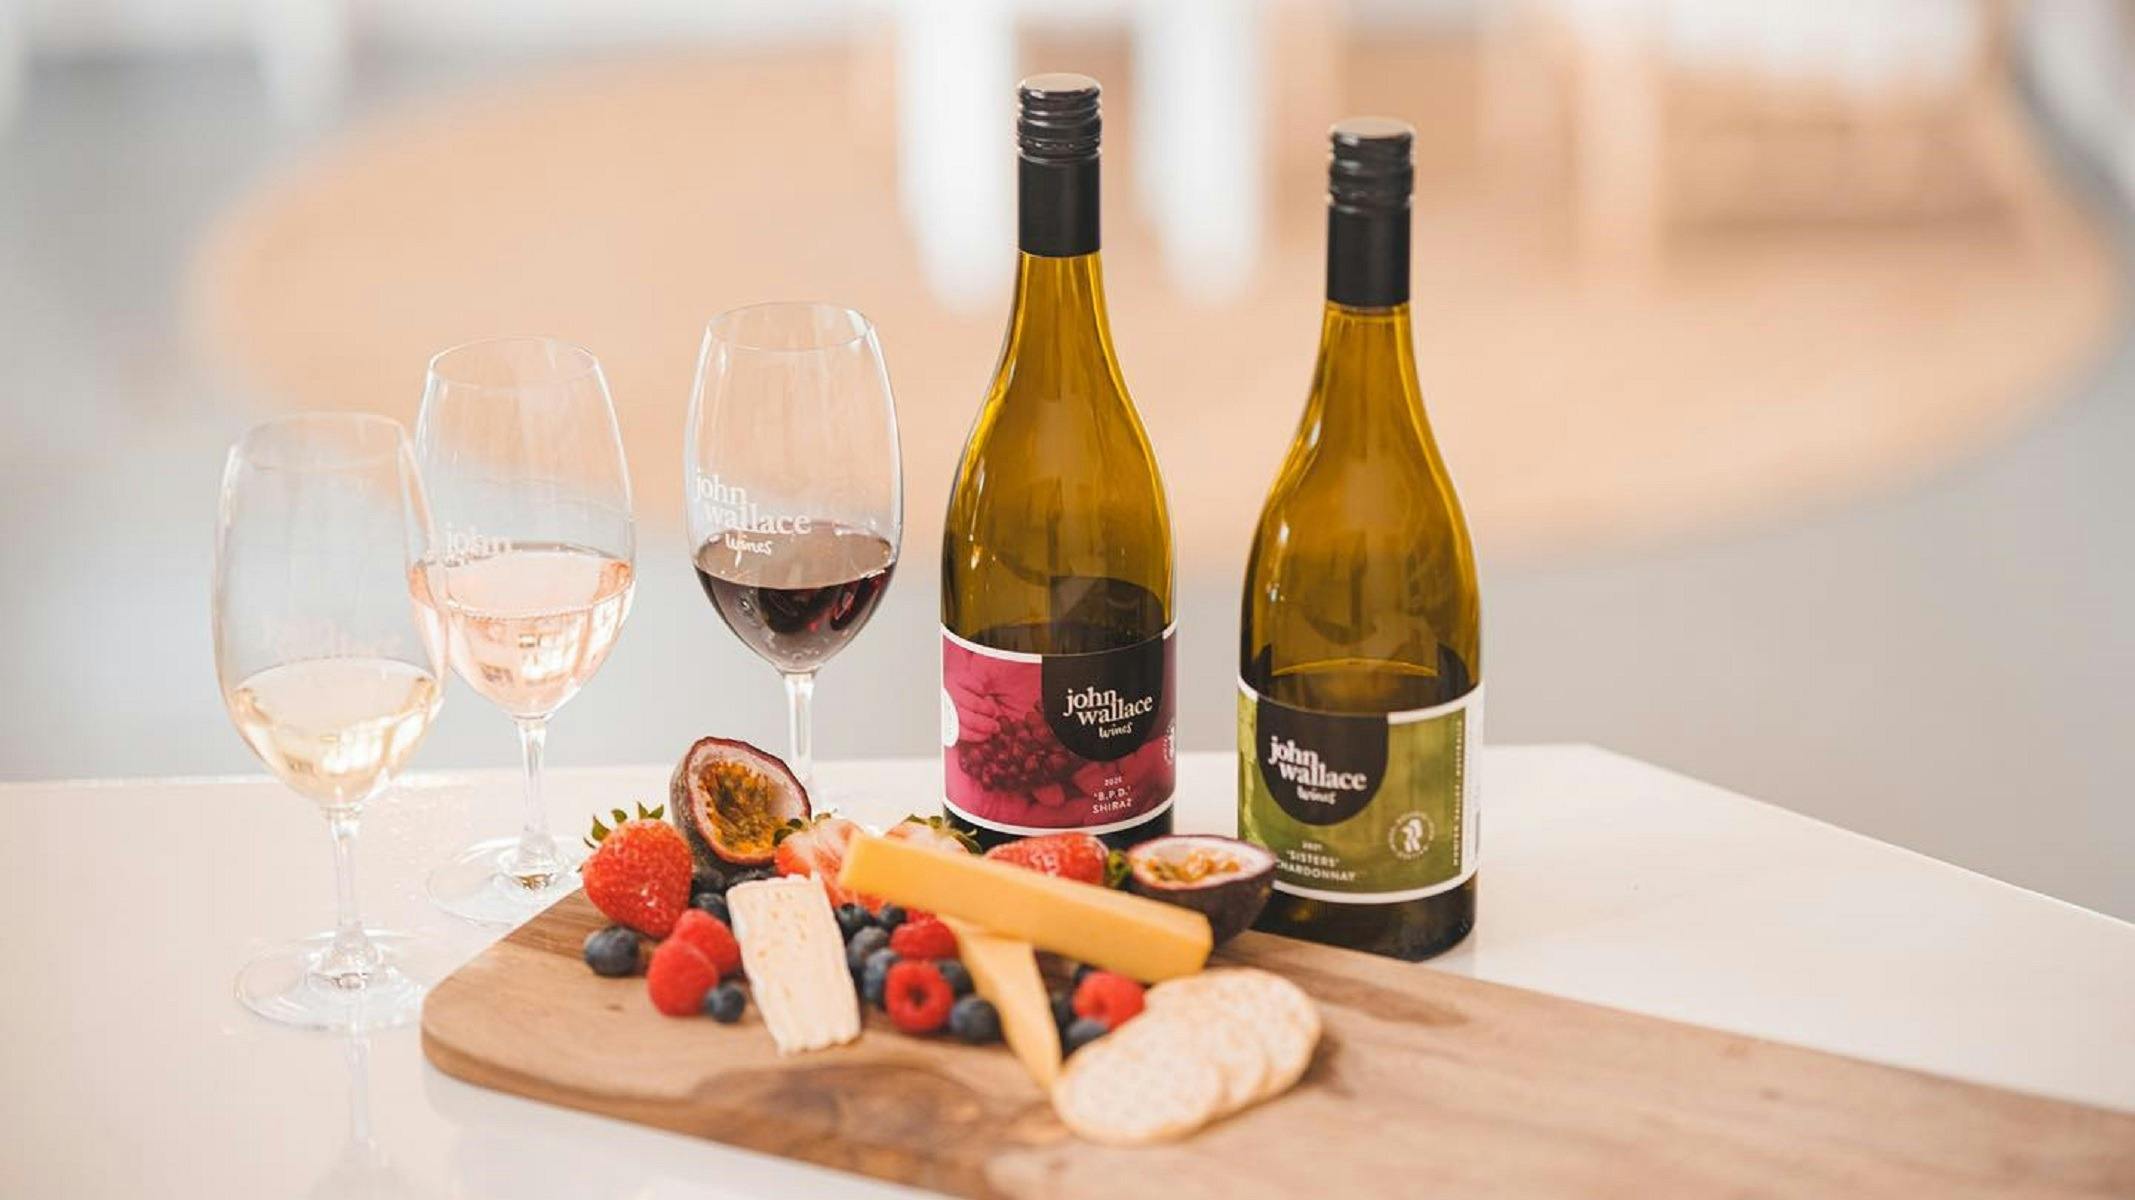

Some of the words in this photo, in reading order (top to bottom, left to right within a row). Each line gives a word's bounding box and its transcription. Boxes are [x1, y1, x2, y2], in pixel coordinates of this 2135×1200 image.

[695, 467, 748, 503] john
[703, 503, 813, 535] wallace
[725, 532, 774, 556] wines
[1062, 686, 1117, 717] john
[1077, 696, 1154, 726] wallace
[1098, 721, 1134, 739] wines
[1268, 735, 1319, 766] john
[1279, 761, 1367, 791] wallace
[1092, 798, 1133, 814] SHIRAZ
[1296, 784, 1337, 805] wines
